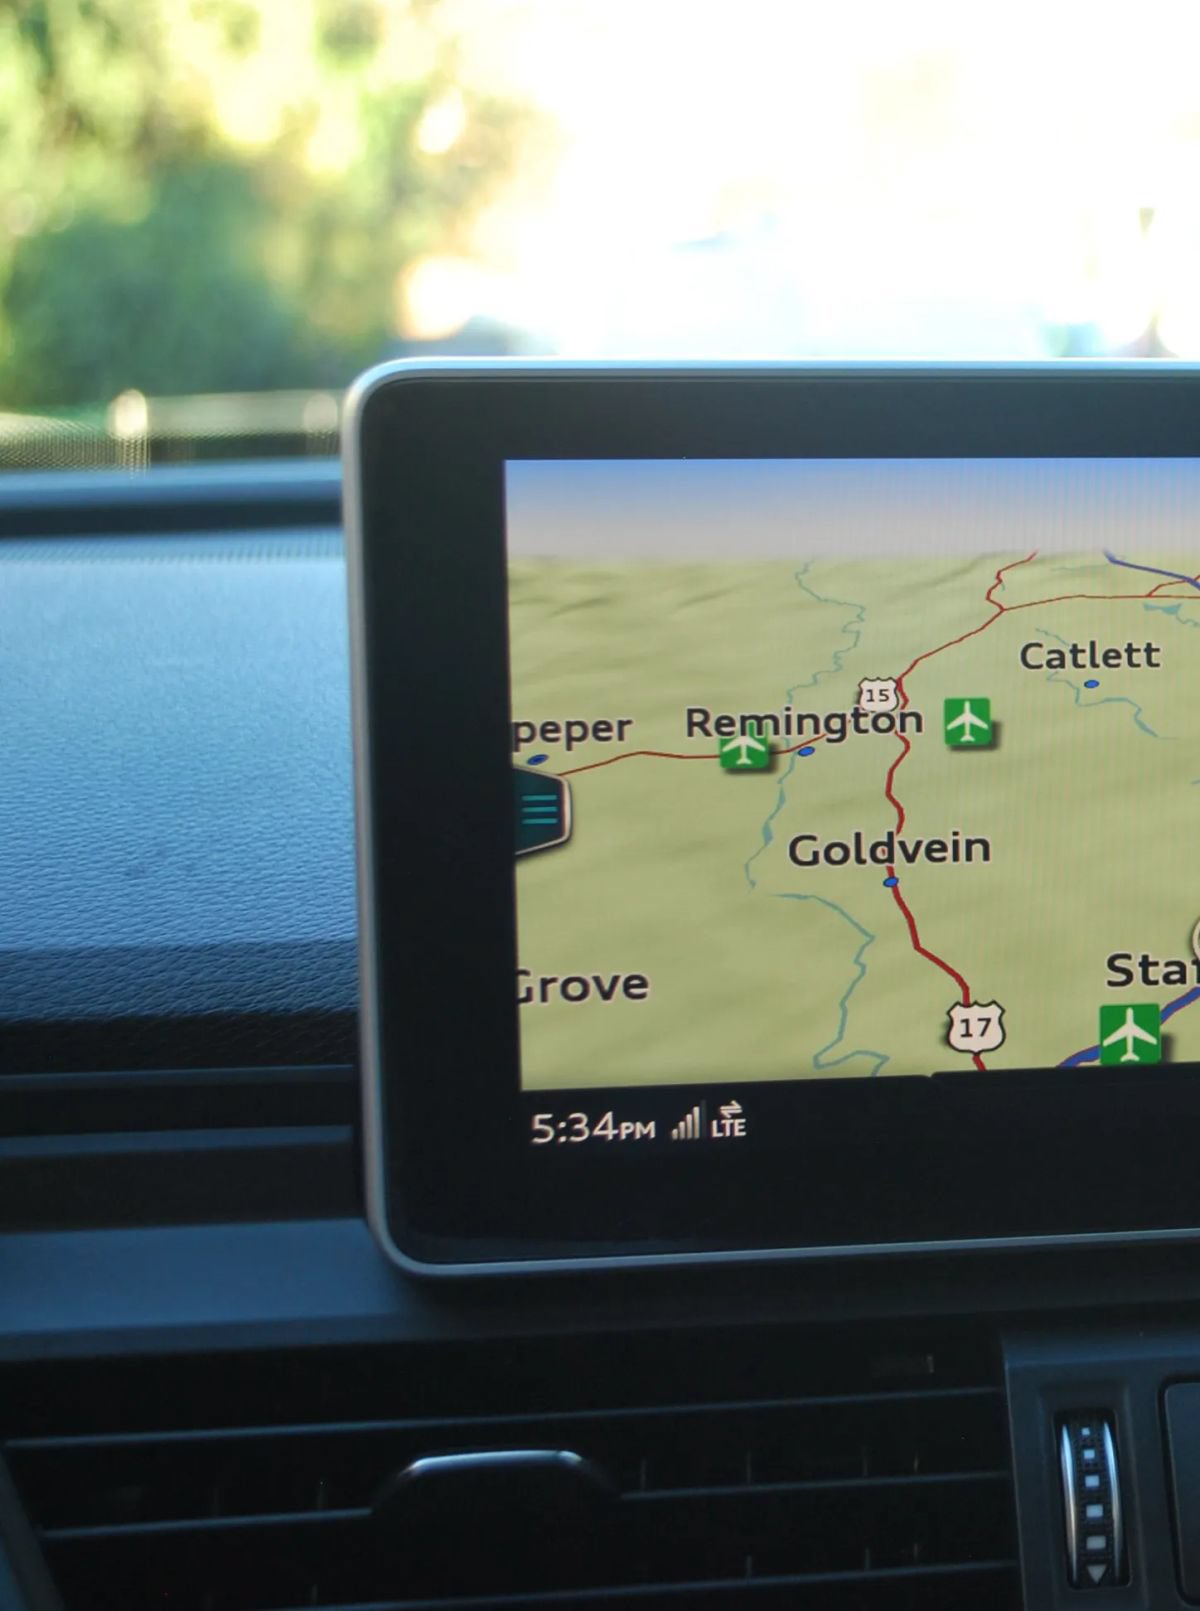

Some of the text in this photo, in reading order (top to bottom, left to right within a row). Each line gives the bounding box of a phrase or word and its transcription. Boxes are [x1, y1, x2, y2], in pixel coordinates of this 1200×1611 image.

[1020, 642, 1161, 670] Catlett
[865, 688, 890, 703] 15
[514, 717, 633, 750] peper
[686, 707, 923, 742] Remington
[789, 832, 991, 866] Goldvein
[960, 1018, 992, 1038] 17
[711, 1117, 747, 1138] LTE
